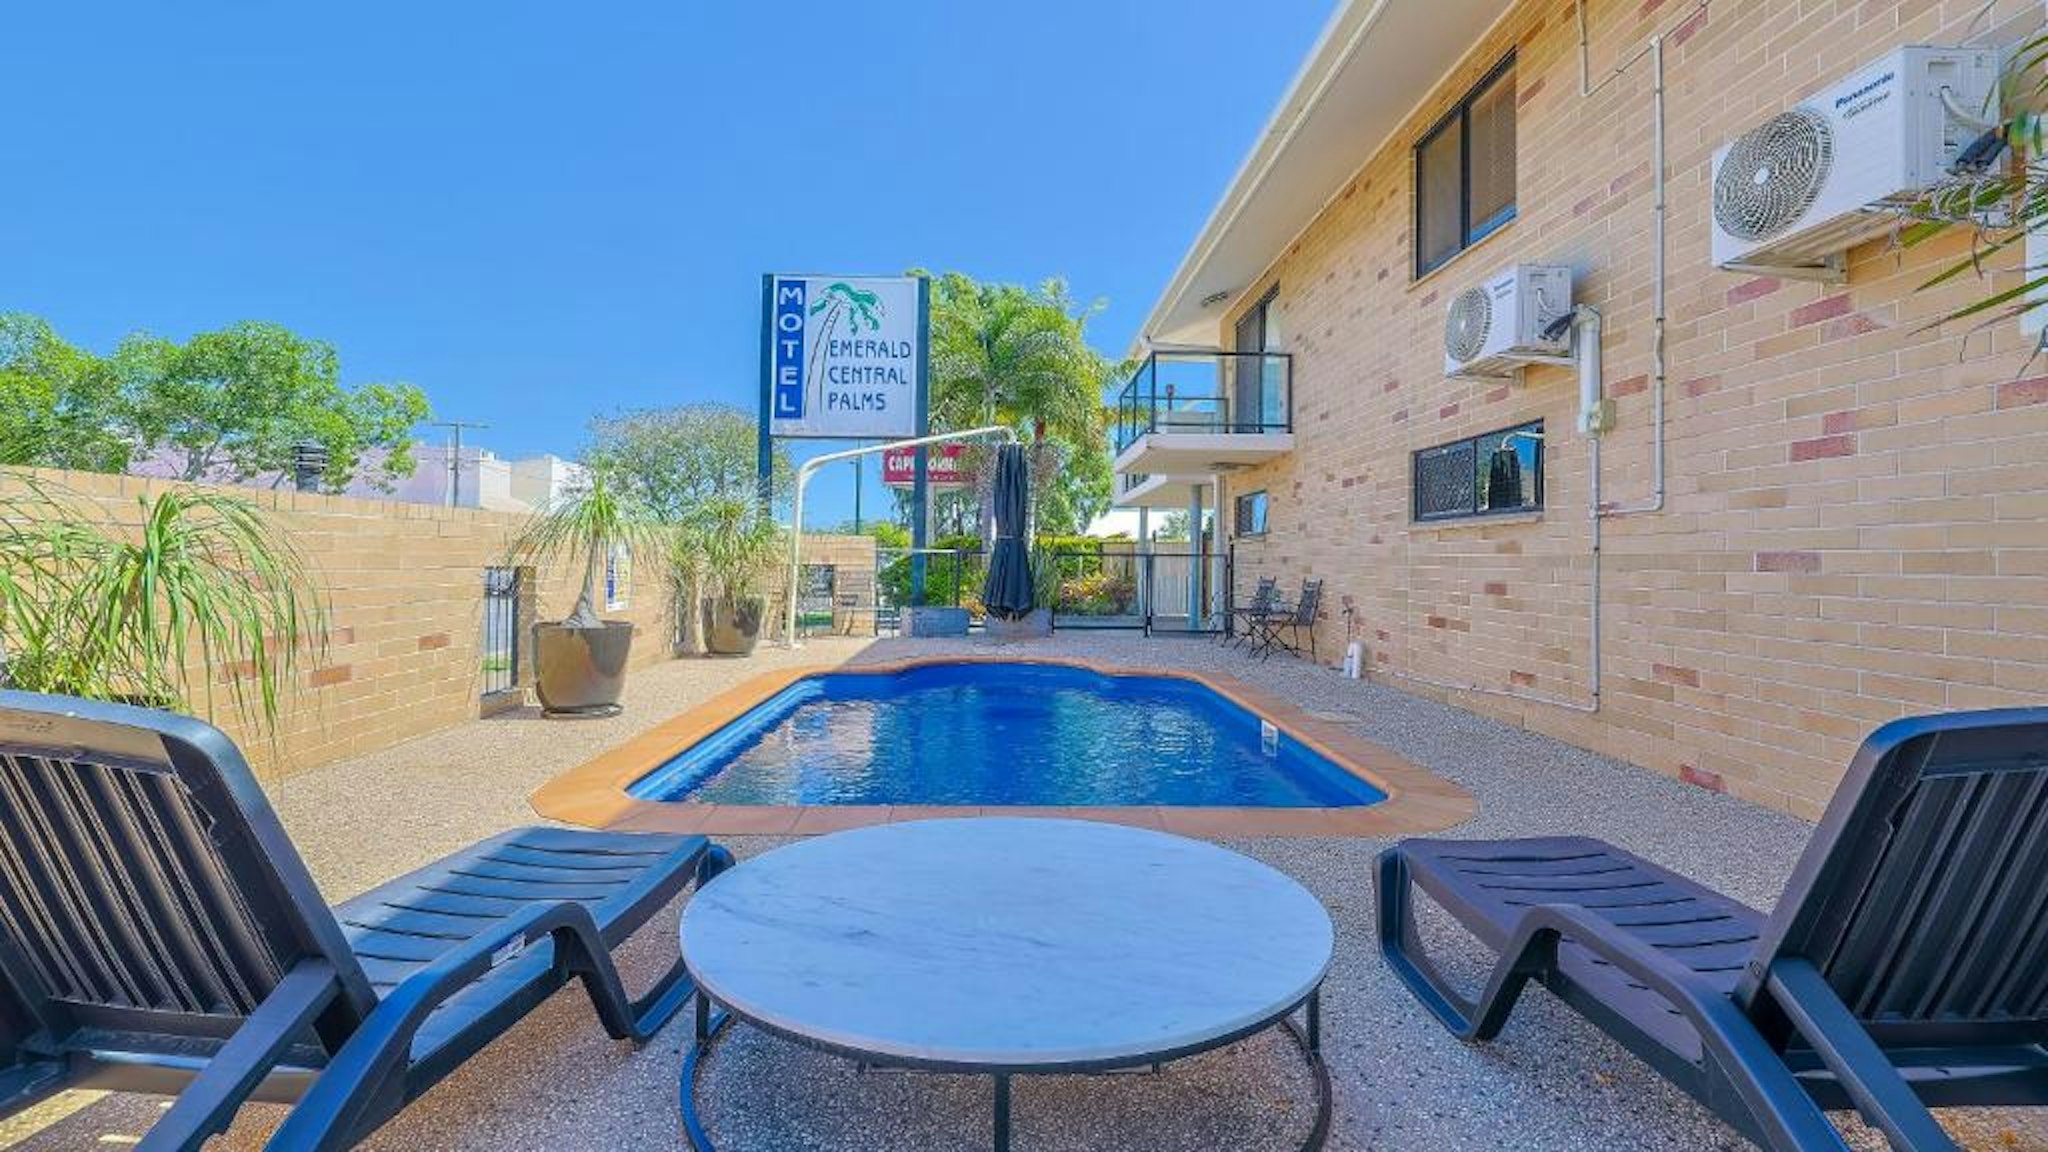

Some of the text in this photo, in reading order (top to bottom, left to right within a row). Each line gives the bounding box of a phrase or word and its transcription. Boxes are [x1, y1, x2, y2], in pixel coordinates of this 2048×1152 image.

[778, 286, 803, 412] MOTEL
[829, 339, 911, 358] EMERALD
[828, 365, 907, 384] CENTRAL
[828, 392, 886, 411] PALMS
